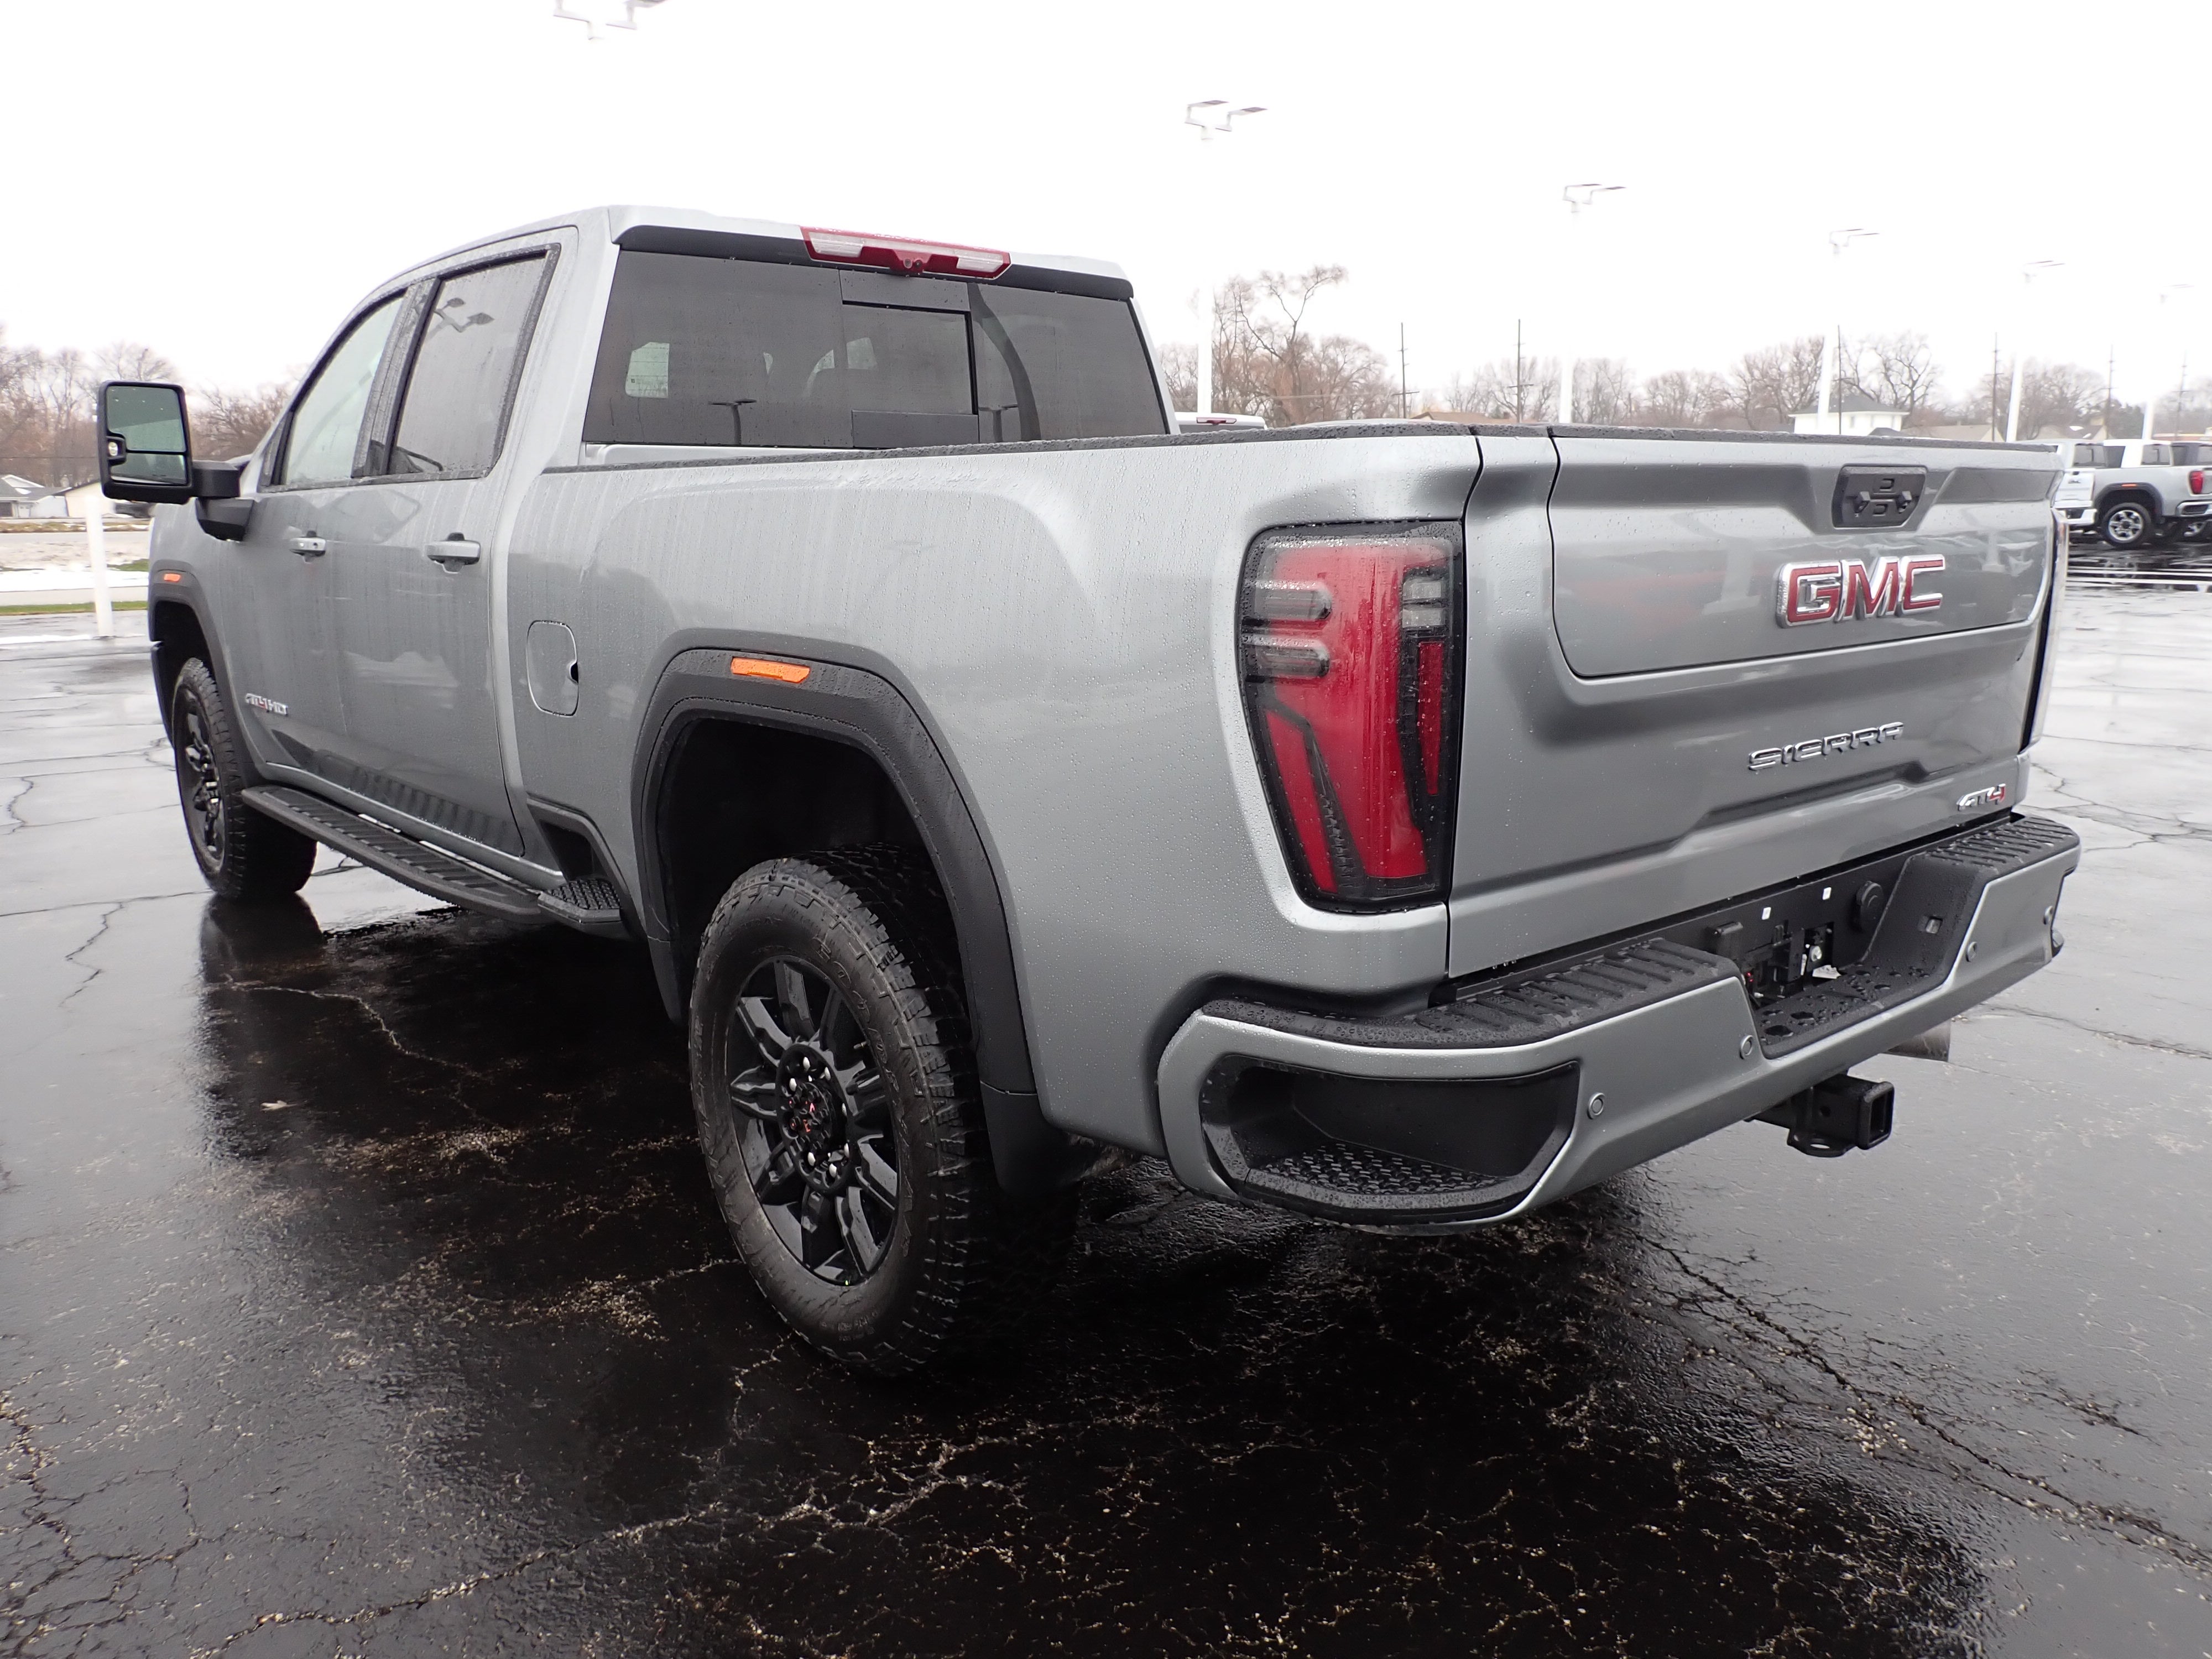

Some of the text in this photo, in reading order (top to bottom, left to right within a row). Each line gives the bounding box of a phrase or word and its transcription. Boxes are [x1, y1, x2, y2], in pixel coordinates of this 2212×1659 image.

[1777, 554, 1945, 628] GMC
[1748, 721, 1904, 770] SIERRA
[1956, 783, 2006, 811] AT4
